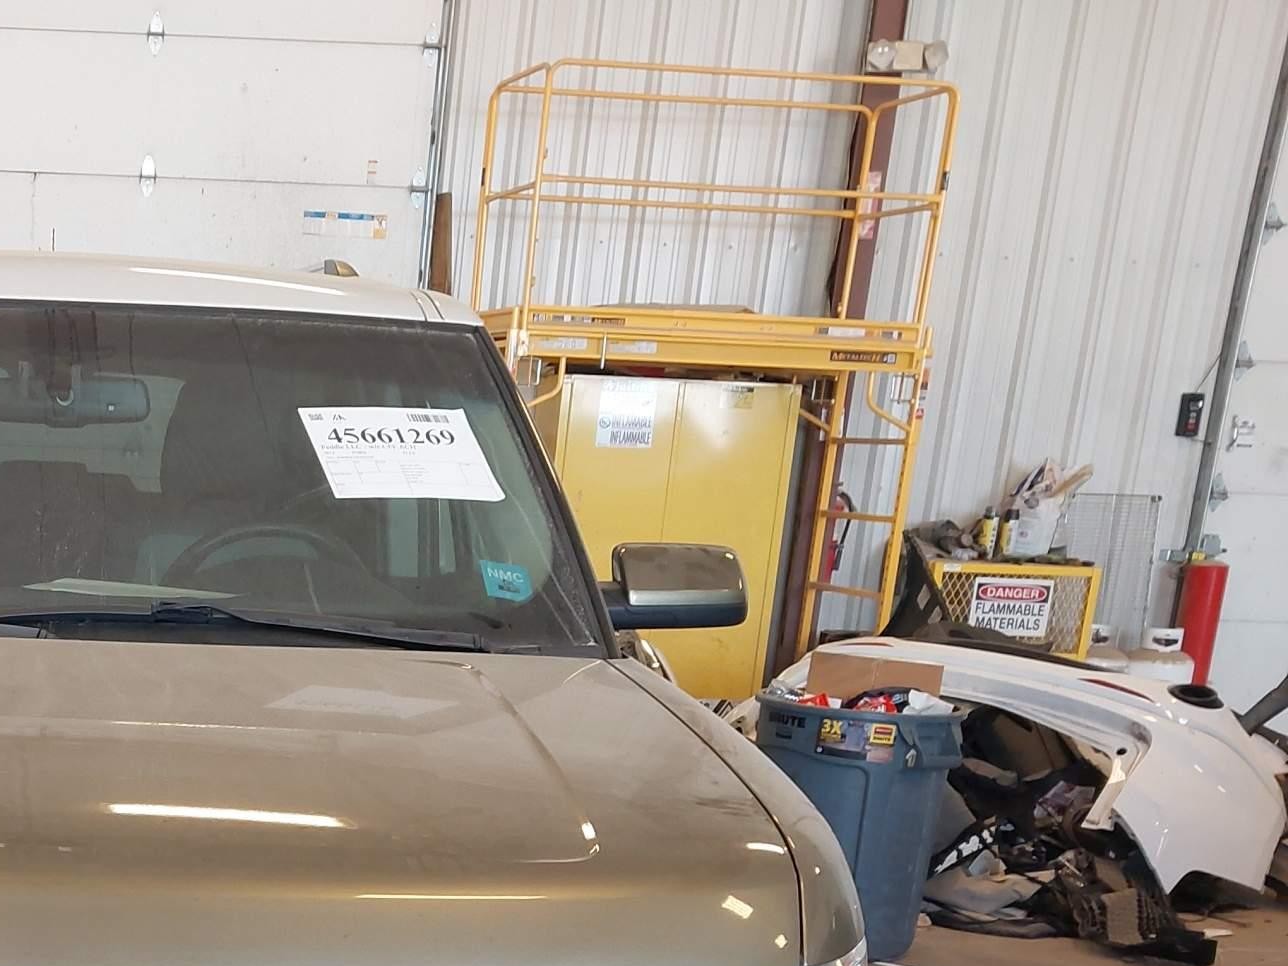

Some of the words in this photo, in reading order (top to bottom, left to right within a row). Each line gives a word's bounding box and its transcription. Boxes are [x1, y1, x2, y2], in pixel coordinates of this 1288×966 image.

[327, 427, 455, 445] 45661269
[487, 567, 524, 583] NMC
[987, 587, 1040, 599] DANGER
[975, 602, 1045, 617] FLAMMABLE
[975, 616, 1040, 631] MATERIALS
[821, 719, 843, 734] 3X
